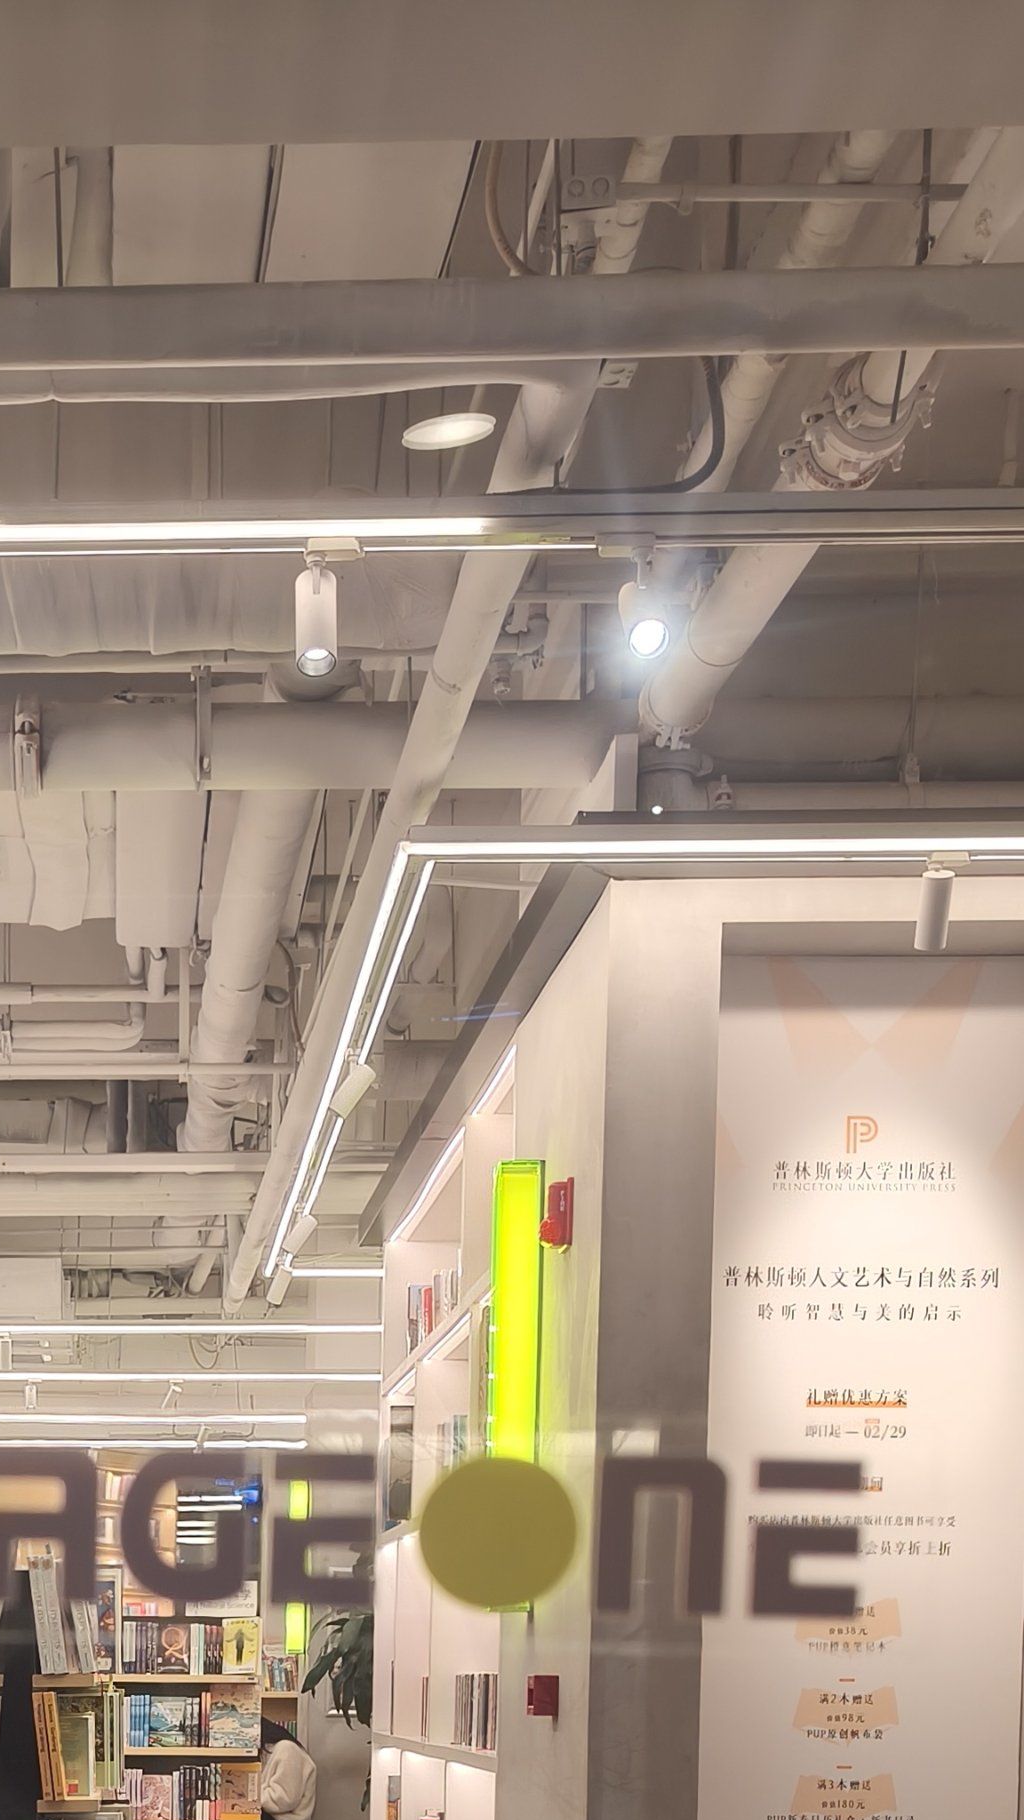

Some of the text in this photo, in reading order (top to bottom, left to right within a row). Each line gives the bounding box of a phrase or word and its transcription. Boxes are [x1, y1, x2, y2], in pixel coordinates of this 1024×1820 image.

[773, 1160, 957, 1181] 普林斯顿大学出版社
[772, 1182, 956, 1192] PRINCETON UNIVERSITY PRESS
[723, 1265, 1000, 1289] 普林斯顿人文艺术与自然系列
[758, 1302, 962, 1322] 聆听智慧与美的启示
[807, 1388, 907, 1406] 礼赠优惠方案
